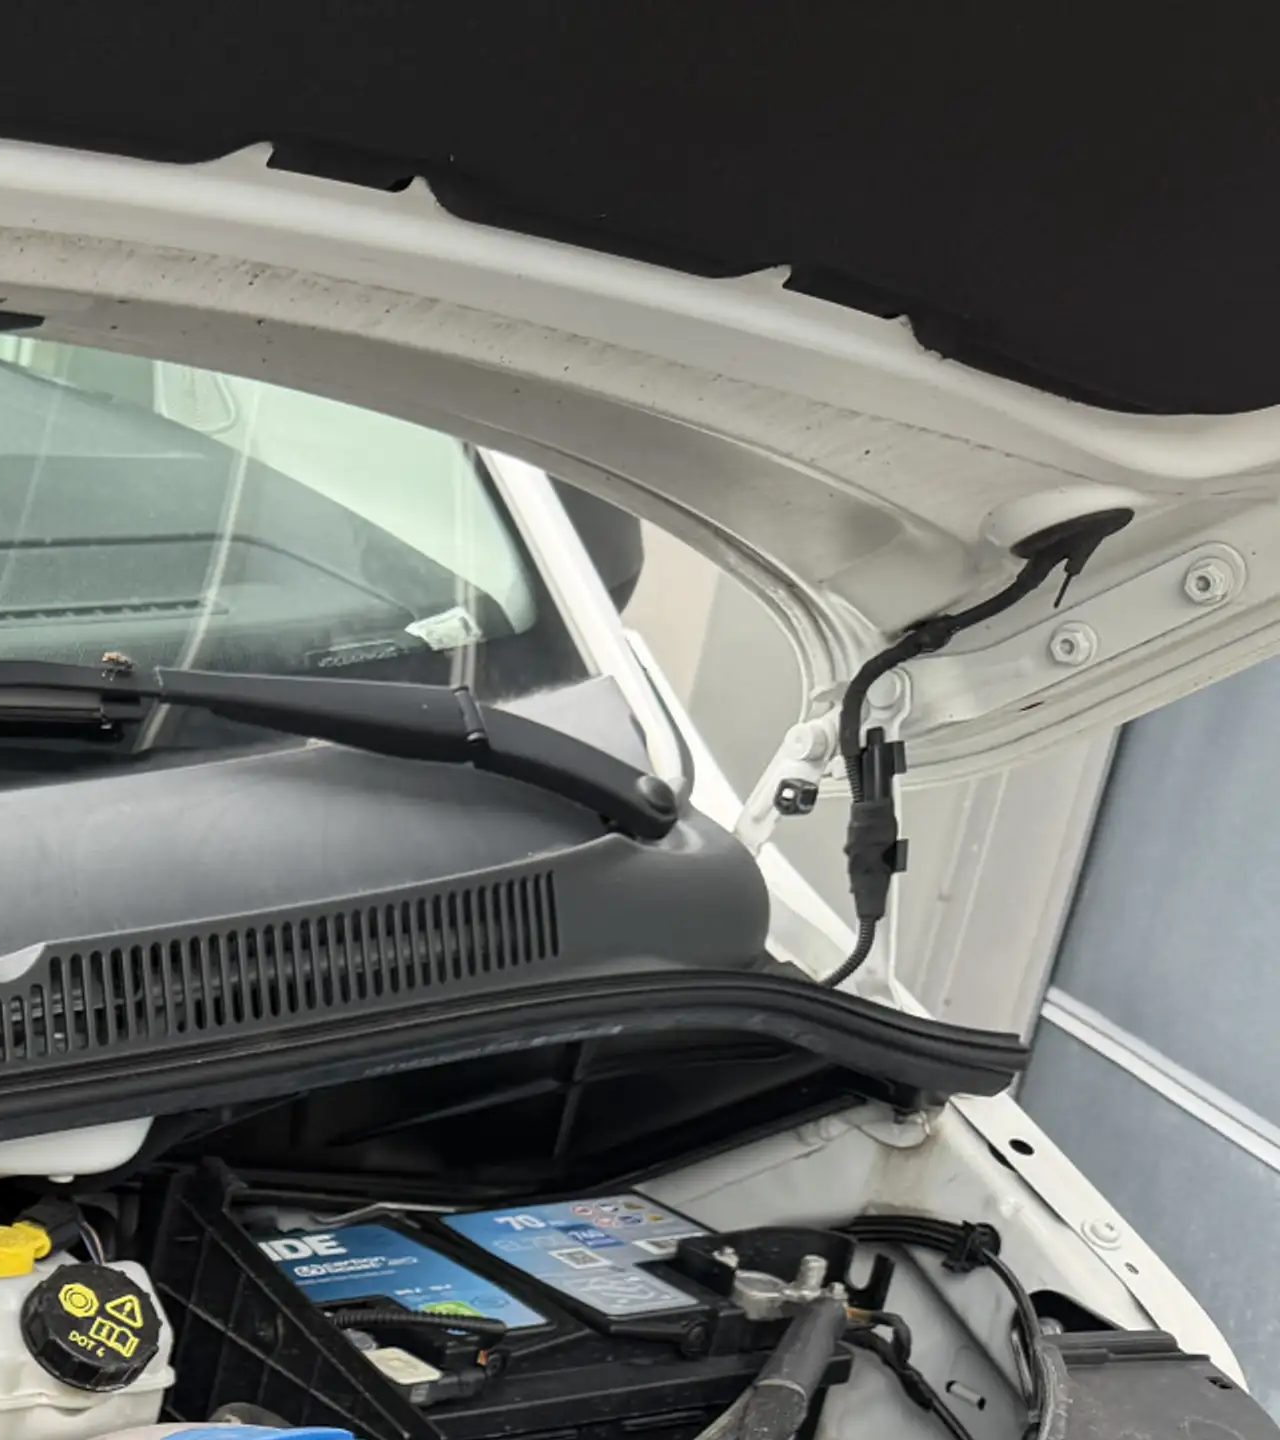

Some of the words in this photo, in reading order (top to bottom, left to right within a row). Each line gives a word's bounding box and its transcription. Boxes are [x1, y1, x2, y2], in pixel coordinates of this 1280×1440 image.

[493, 1213, 546, 1231] 70
[68, 1329, 96, 1351] DOT
[96, 1346, 106, 1359] 4
